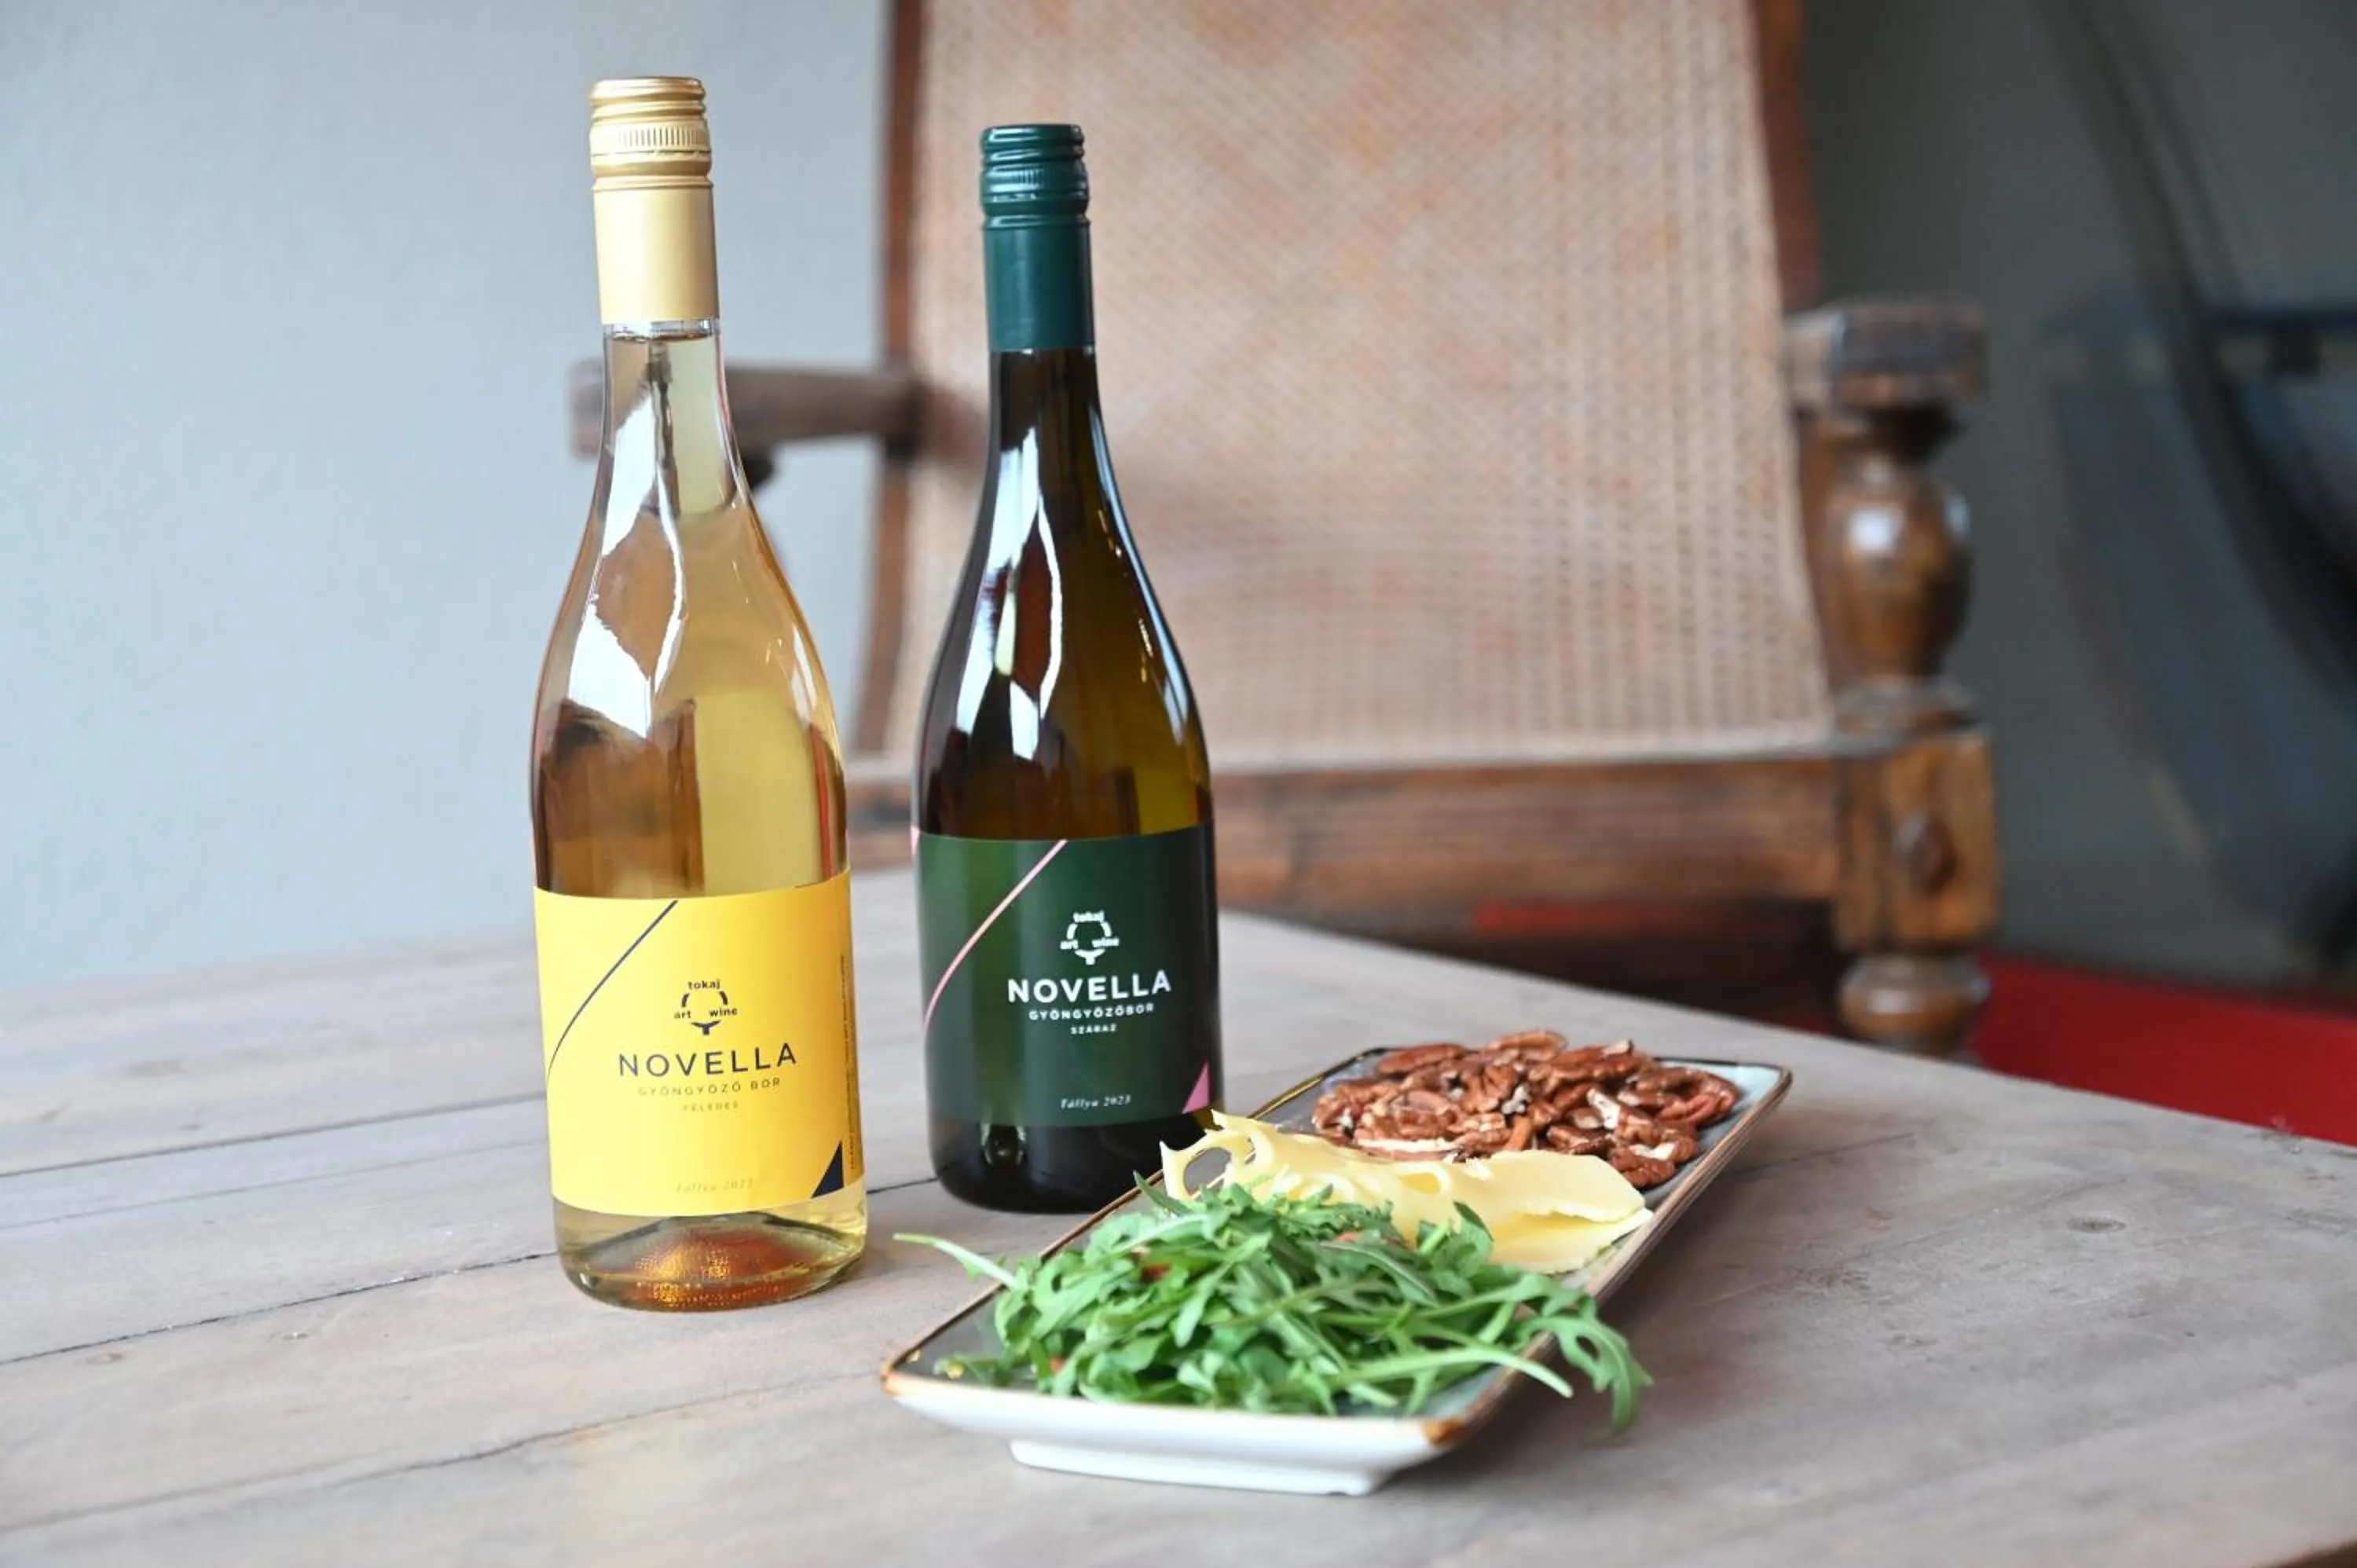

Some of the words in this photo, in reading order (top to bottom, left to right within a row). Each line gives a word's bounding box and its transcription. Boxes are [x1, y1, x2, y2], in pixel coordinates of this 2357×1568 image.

[687, 978, 720, 991] tokaj
[1007, 969, 1171, 1003] NOVELLA
[673, 1009, 691, 1019] art
[709, 1006, 738, 1017] wine
[618, 1042, 797, 1077] NOVELLA
[750, 1077, 781, 1090] BOR
